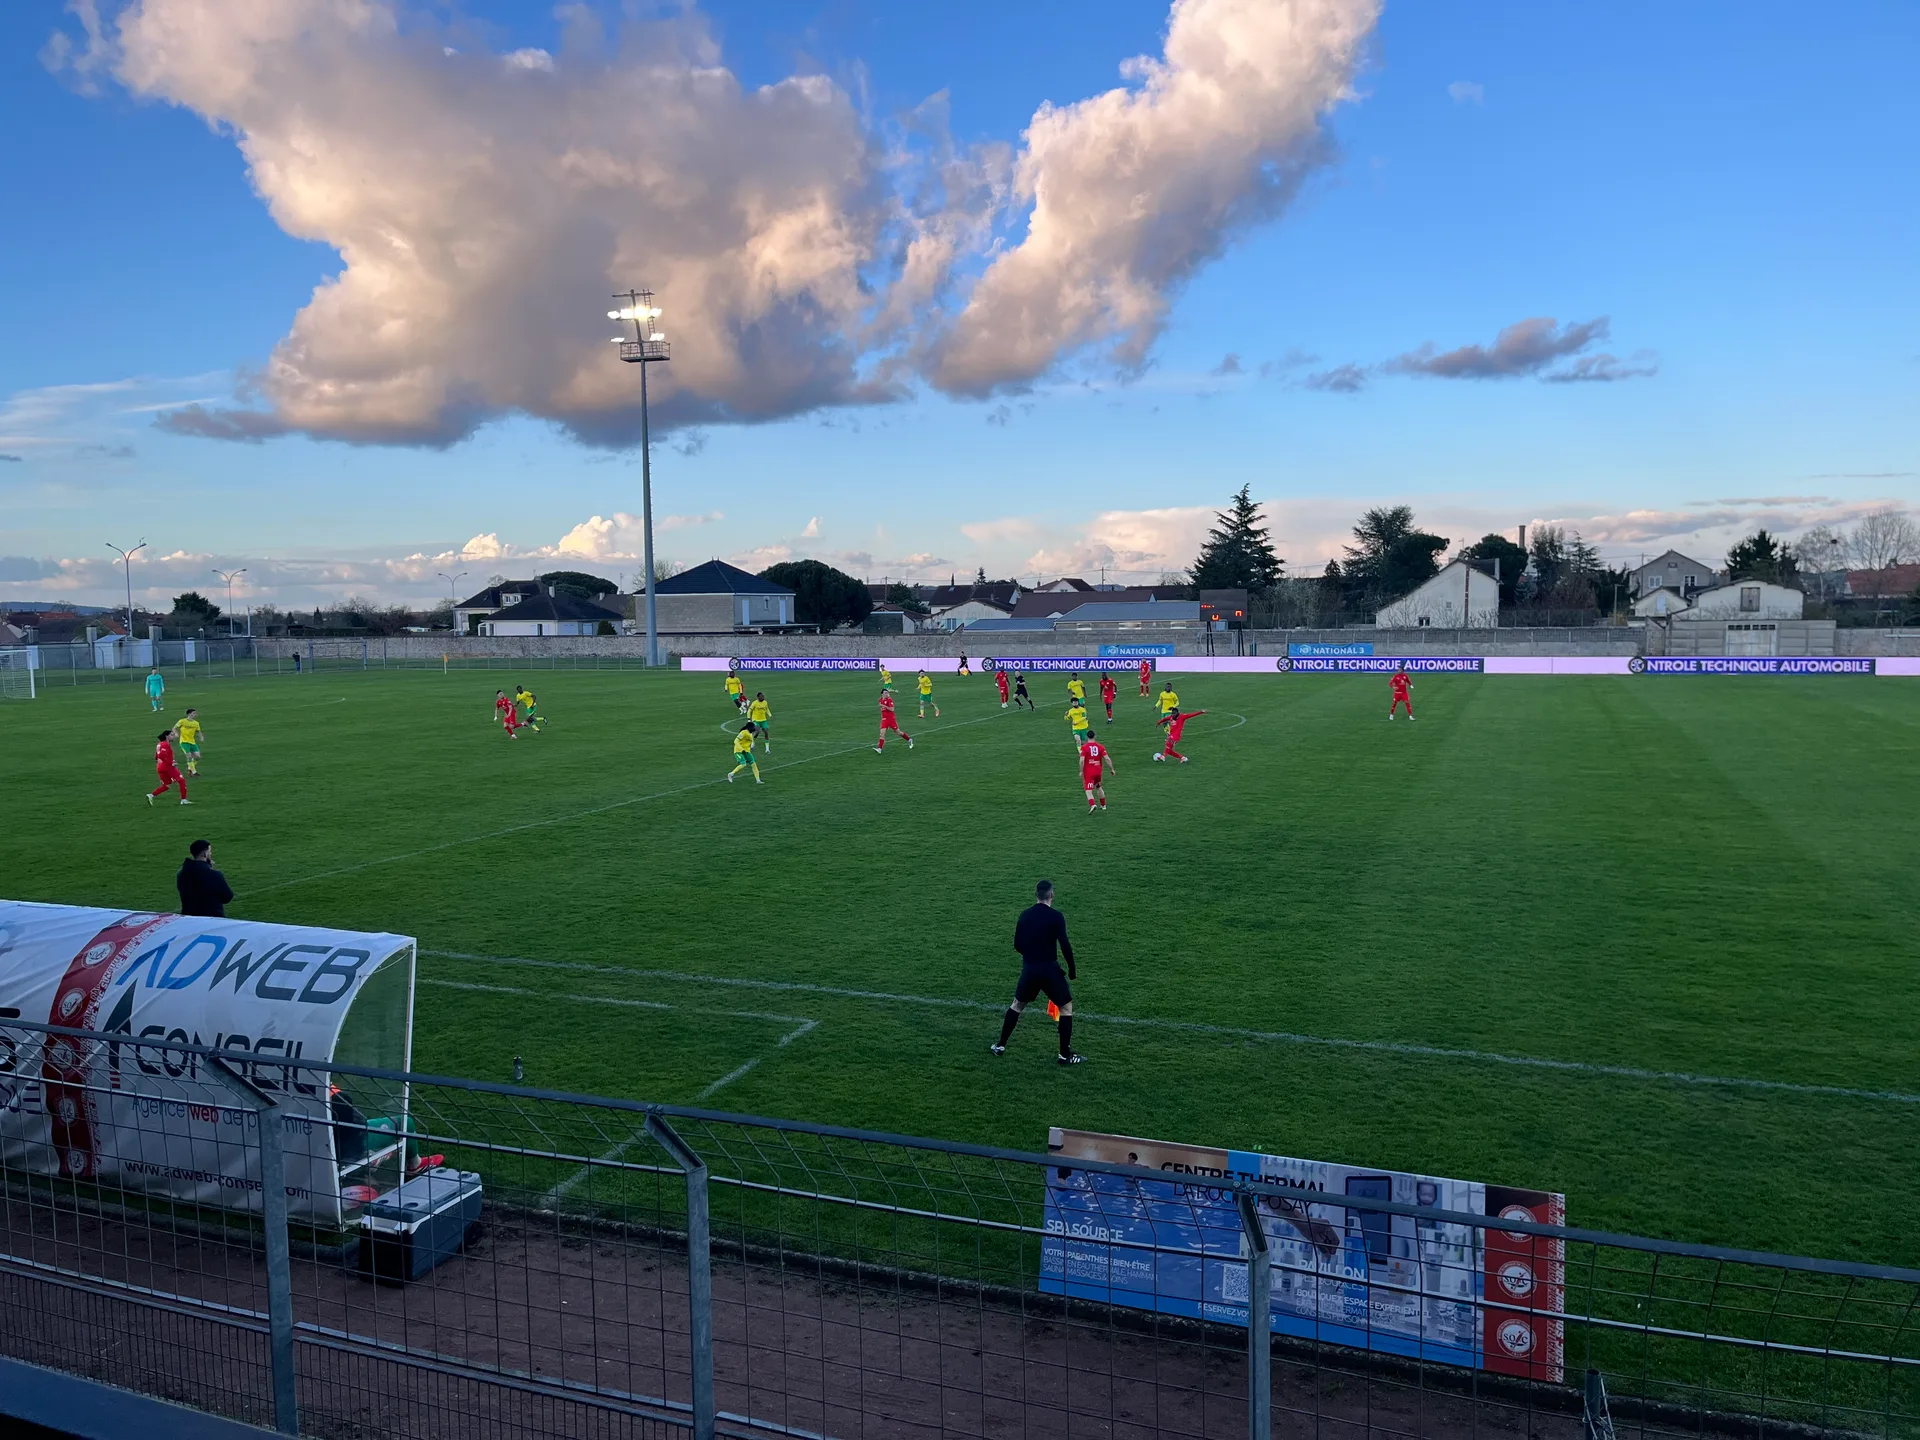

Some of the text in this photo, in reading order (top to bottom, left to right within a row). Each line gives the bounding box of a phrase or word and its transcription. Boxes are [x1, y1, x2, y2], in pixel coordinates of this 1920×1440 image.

[1313, 647, 1357, 655] NATIONAL
[740, 660, 876, 670] NTROLE TECHNIQUE AUTOMOBILE
[1032, 660, 1086, 670] TECHNIQUE
[1088, 660, 1152, 670] AUTOMOBIE
[1293, 660, 1479, 670] NTROLE TECHNIQUE AUTOMOBILE
[1647, 660, 1870, 673] NTROLE TECHNIQUE AUTOMOBILE
[1089, 745, 1099, 757] 19
